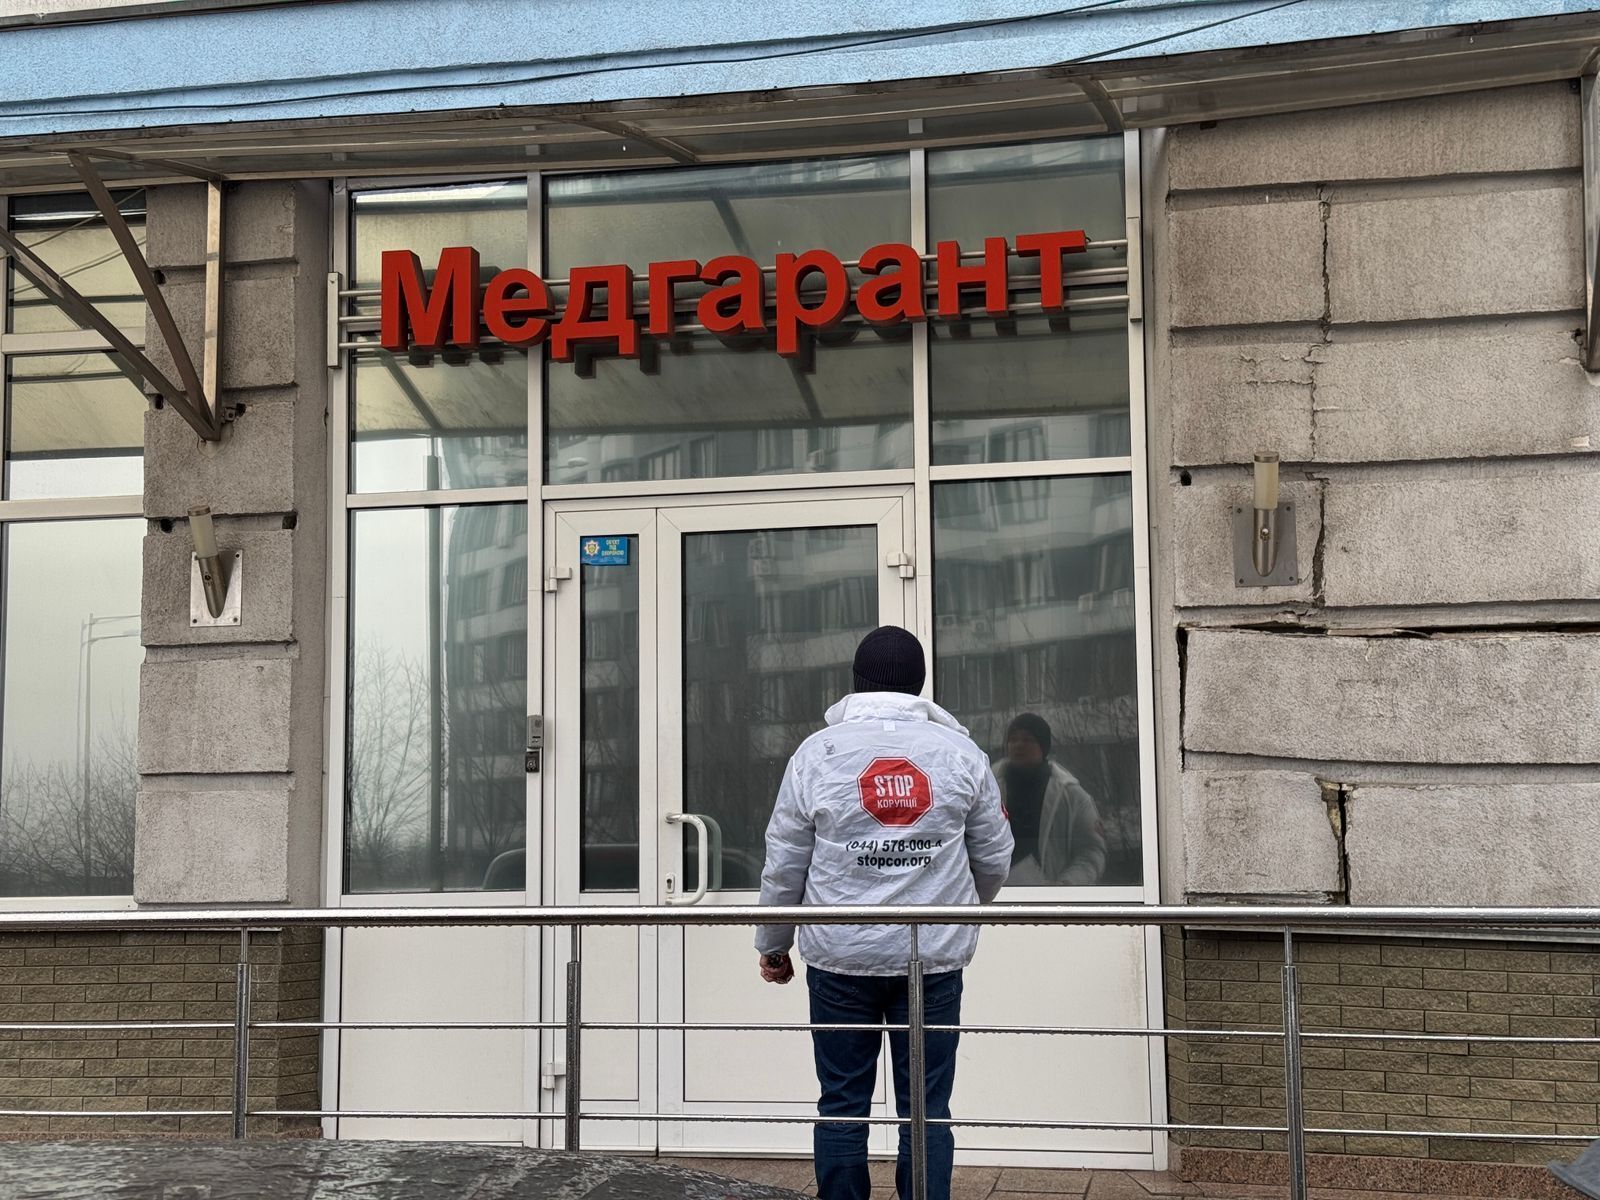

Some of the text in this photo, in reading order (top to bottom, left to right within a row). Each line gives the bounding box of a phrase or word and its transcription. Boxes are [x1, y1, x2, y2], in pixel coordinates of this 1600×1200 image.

[380, 229, 1087, 359] Медгарант
[873, 775, 914, 797] STOP
[877, 797, 917, 809] КОРУПЦІЇ
[857, 854, 931, 869] stopcor.org
